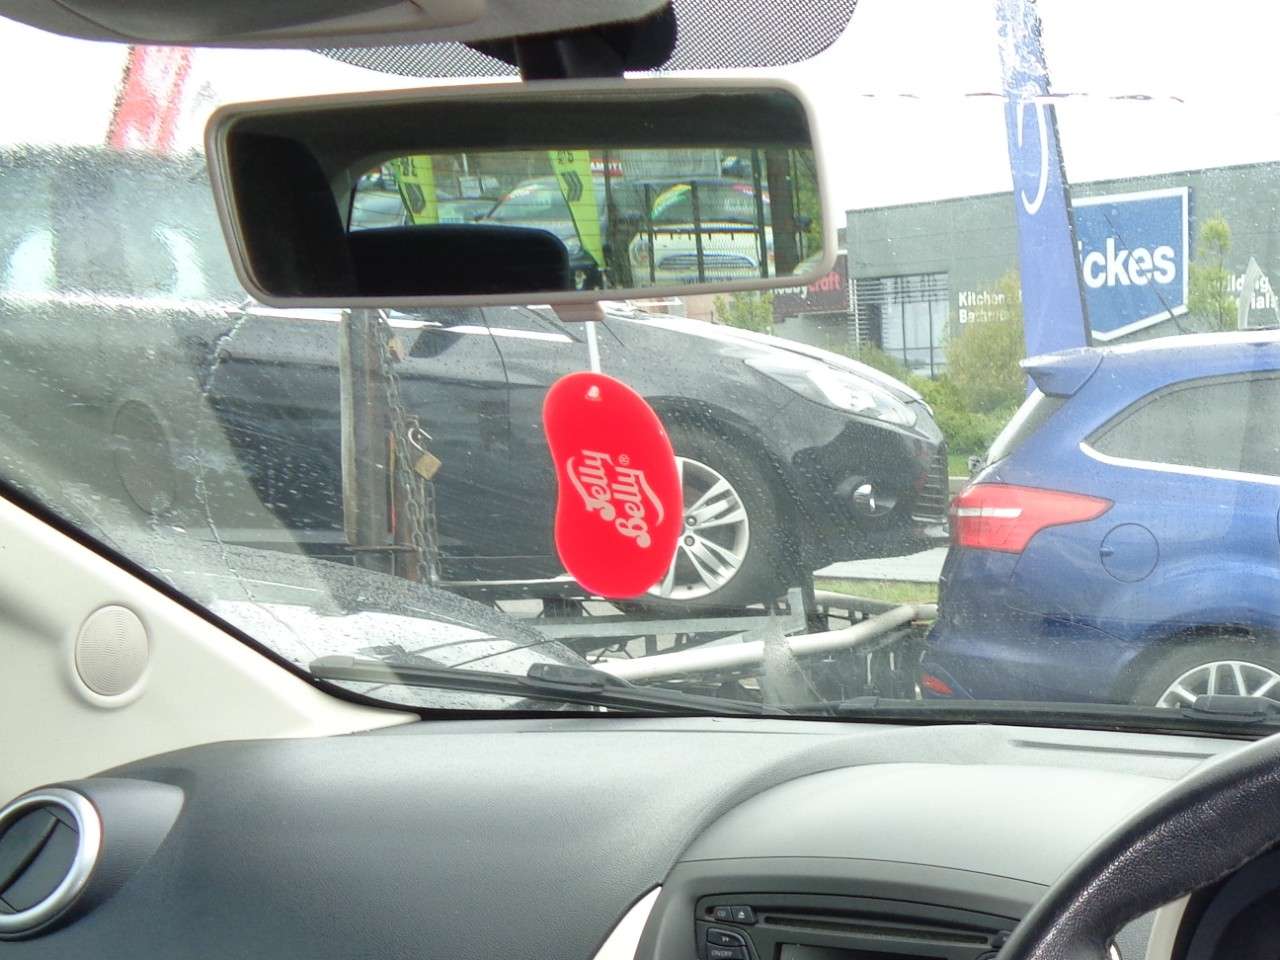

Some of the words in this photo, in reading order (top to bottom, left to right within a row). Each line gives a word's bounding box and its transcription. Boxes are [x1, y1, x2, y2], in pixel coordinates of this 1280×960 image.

[1077, 237, 1176, 288] ckes
[566, 449, 616, 521] Jelly
[612, 466, 665, 549] Belly
